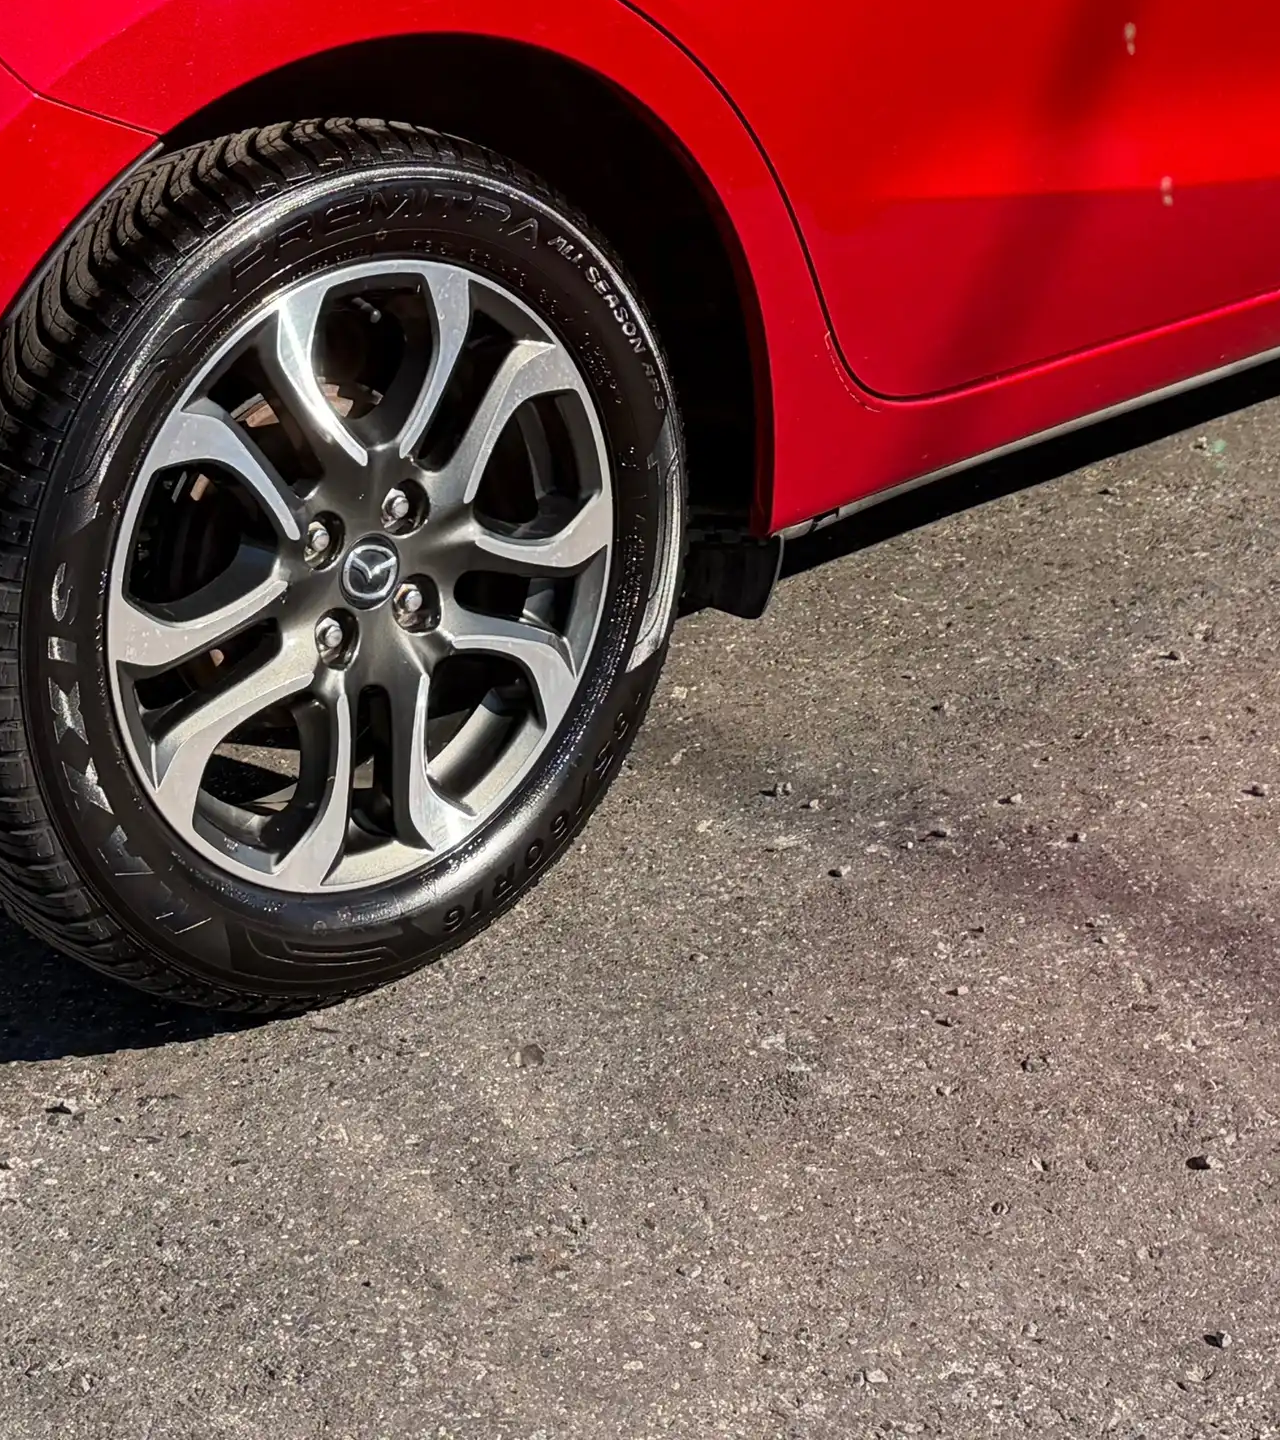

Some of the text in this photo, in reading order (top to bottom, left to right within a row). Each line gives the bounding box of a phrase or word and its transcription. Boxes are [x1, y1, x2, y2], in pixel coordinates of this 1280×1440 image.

[548, 235, 584, 269] ALL
[585, 265, 647, 354] SEASON
[48, 561, 212, 935] MAXXIS
